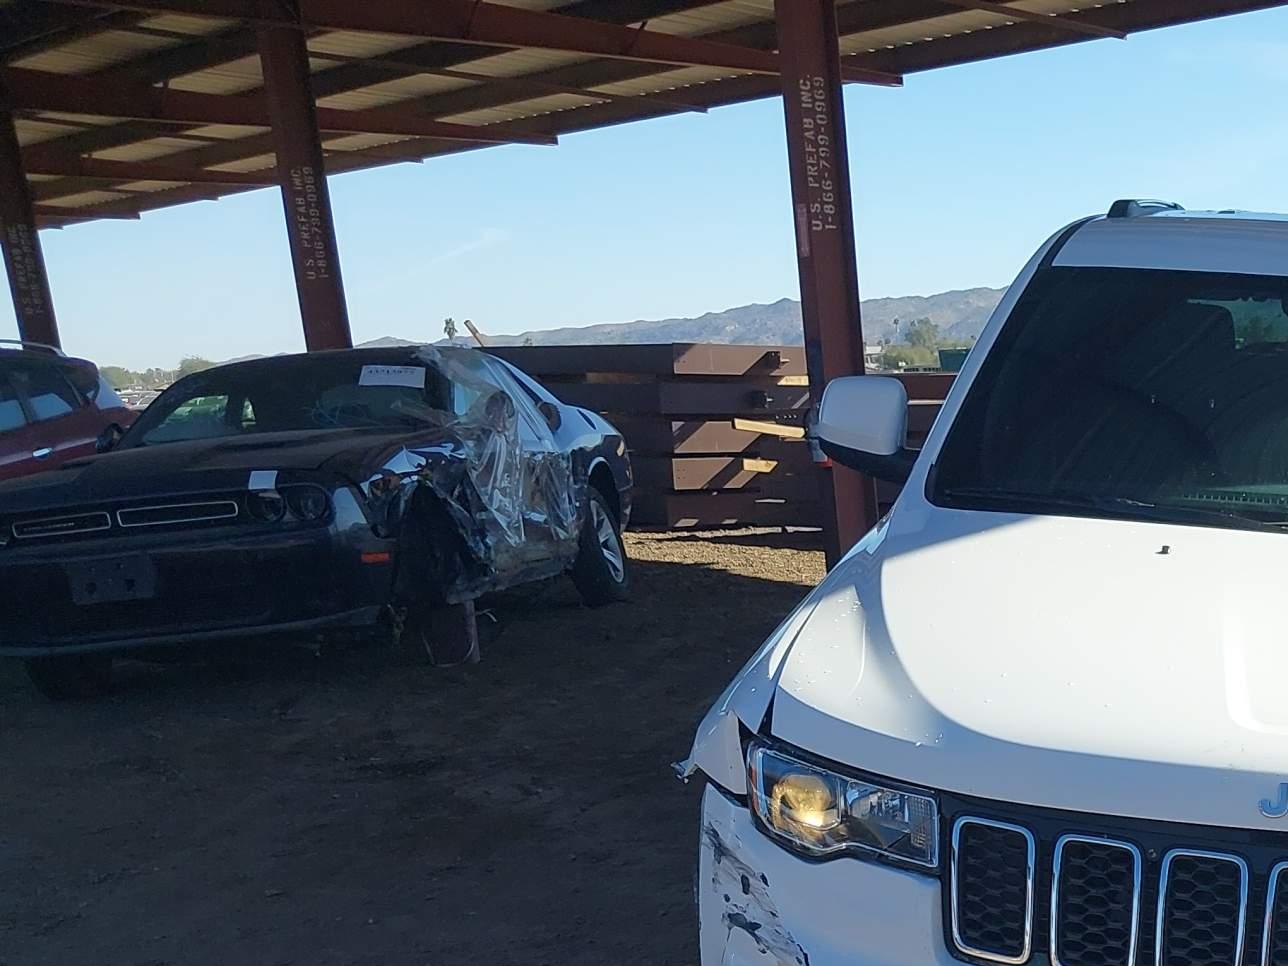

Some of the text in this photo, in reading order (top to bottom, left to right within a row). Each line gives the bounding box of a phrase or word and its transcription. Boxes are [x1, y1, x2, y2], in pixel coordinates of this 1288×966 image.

[799, 74, 823, 231] U.S. PREFAB INC.
[813, 76, 837, 230] 1-866-799-0969
